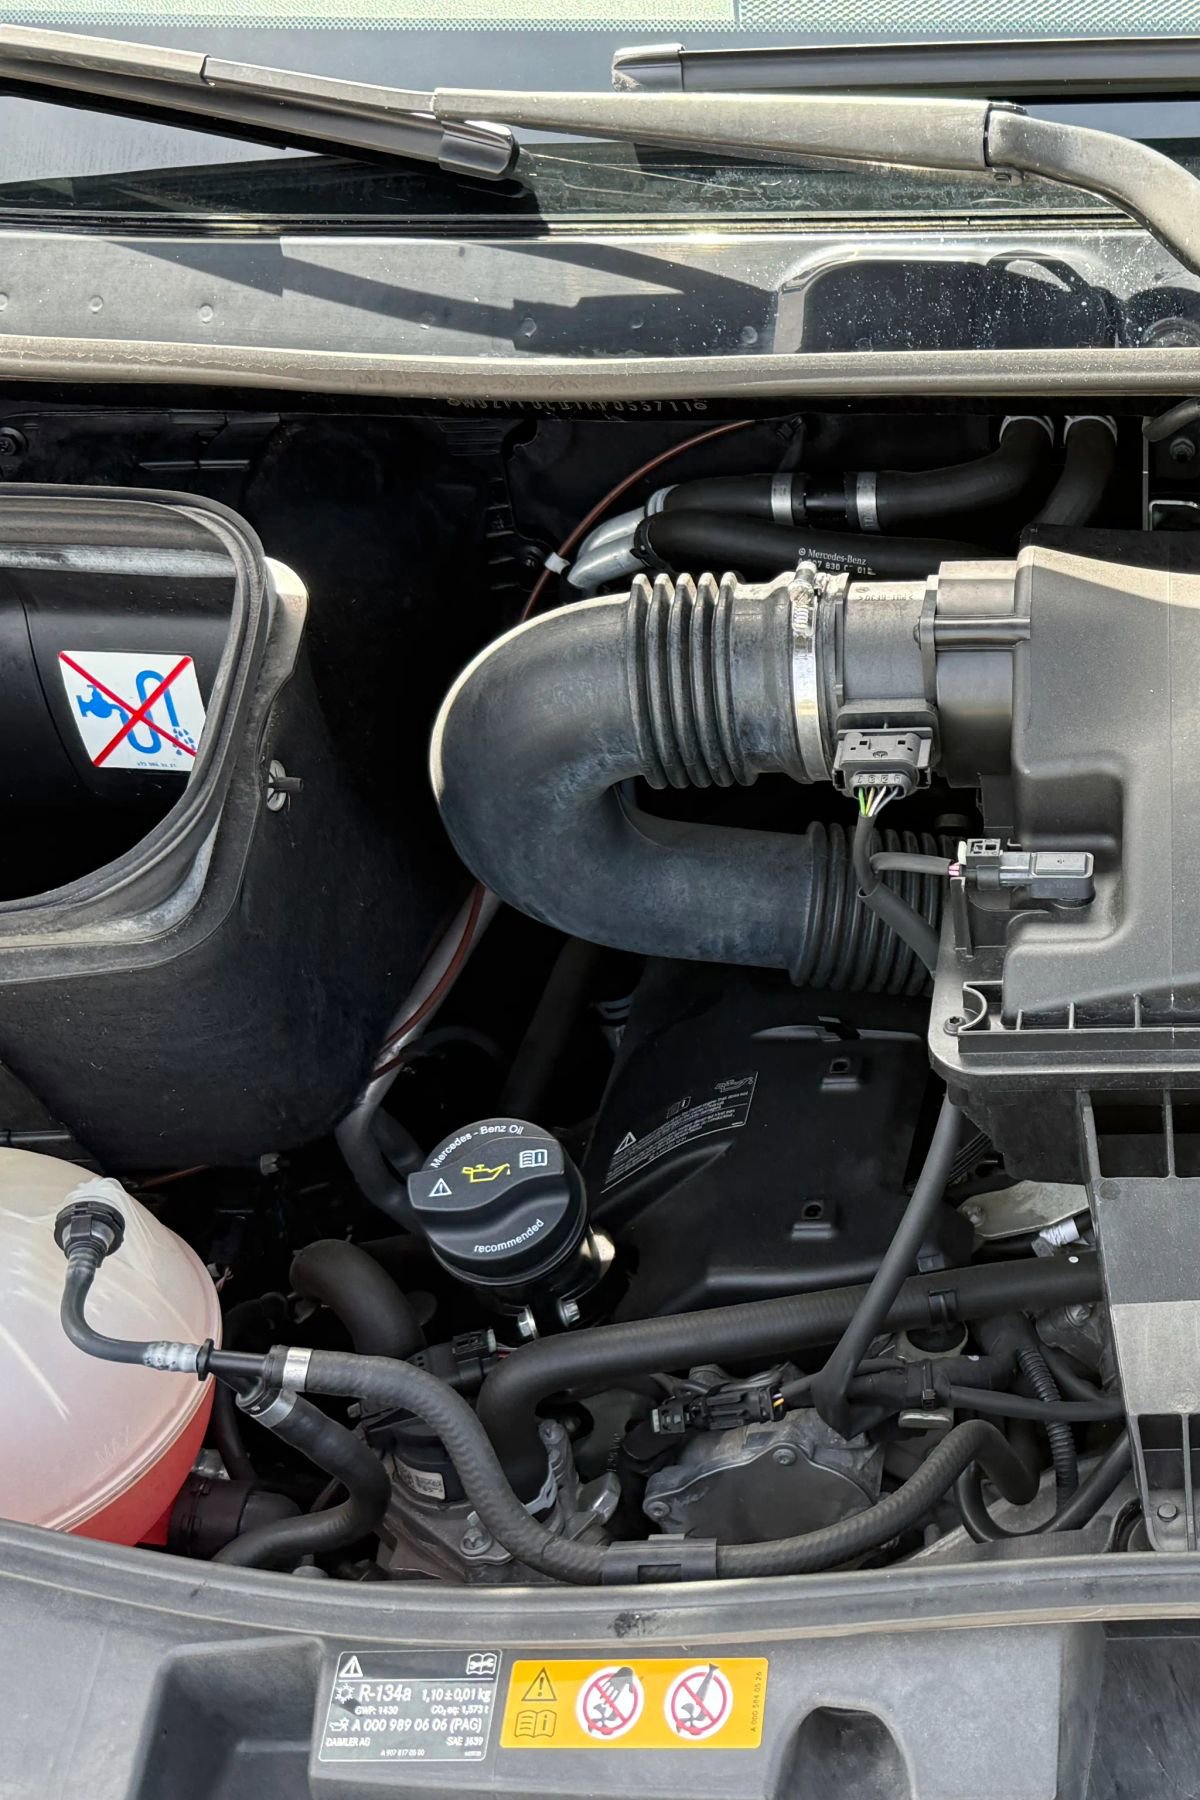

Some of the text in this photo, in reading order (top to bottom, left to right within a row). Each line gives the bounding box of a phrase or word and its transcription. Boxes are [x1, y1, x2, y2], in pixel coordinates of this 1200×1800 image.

[808, 548, 866, 566] Mercedes-Benz
[430, 1132, 473, 1169] Mercedes
[479, 1125, 507, 1134] Benz
[509, 1124, 524, 1135] Oil
[473, 1218, 545, 1253] recommended
[358, 1684, 412, 1701] R-134a
[378, 1706, 399, 1715] 1430
[351, 1717, 482, 1734] A 000 989 06 06 (PAG)
[325, 1737, 371, 1747] DAIMLER AG
